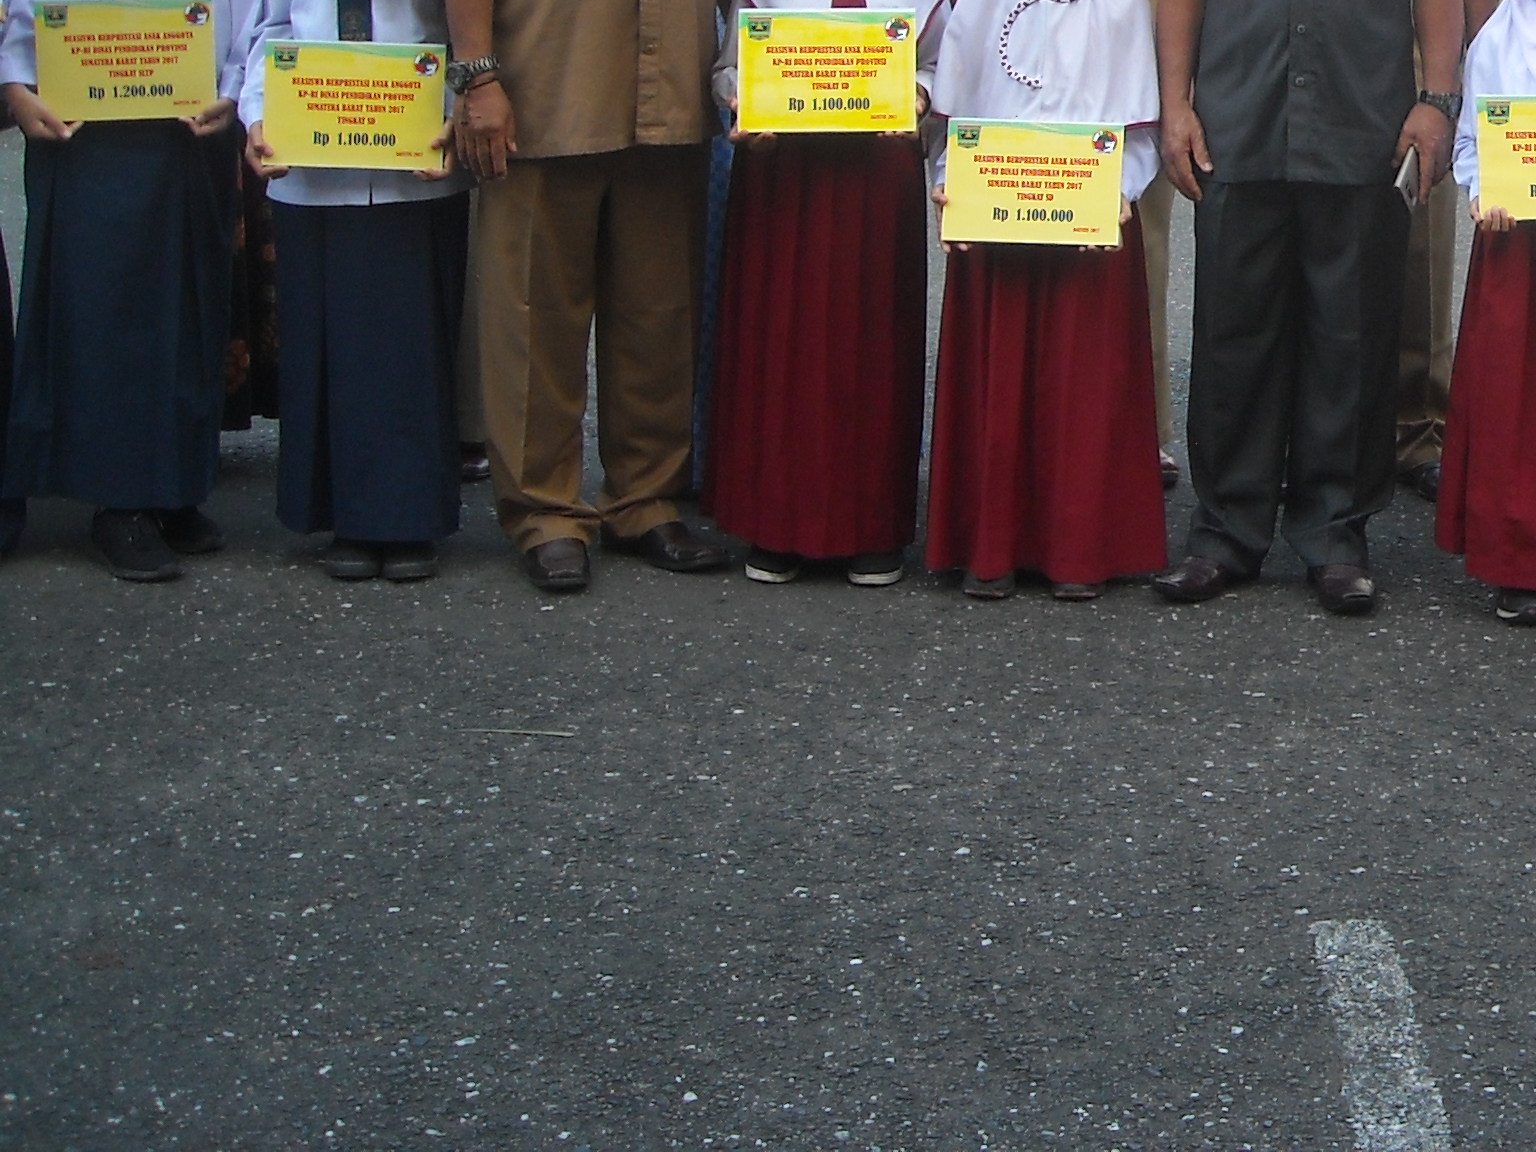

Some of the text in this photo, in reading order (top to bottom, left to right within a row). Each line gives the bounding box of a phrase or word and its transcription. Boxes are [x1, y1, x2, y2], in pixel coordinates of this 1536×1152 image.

[89, 85, 173, 100] Rp 1.200.000
[789, 98, 870, 112] Rp 1.100.000
[313, 131, 396, 146] Rp 1.100.000
[993, 208, 1074, 222] Rp 1.100.000
